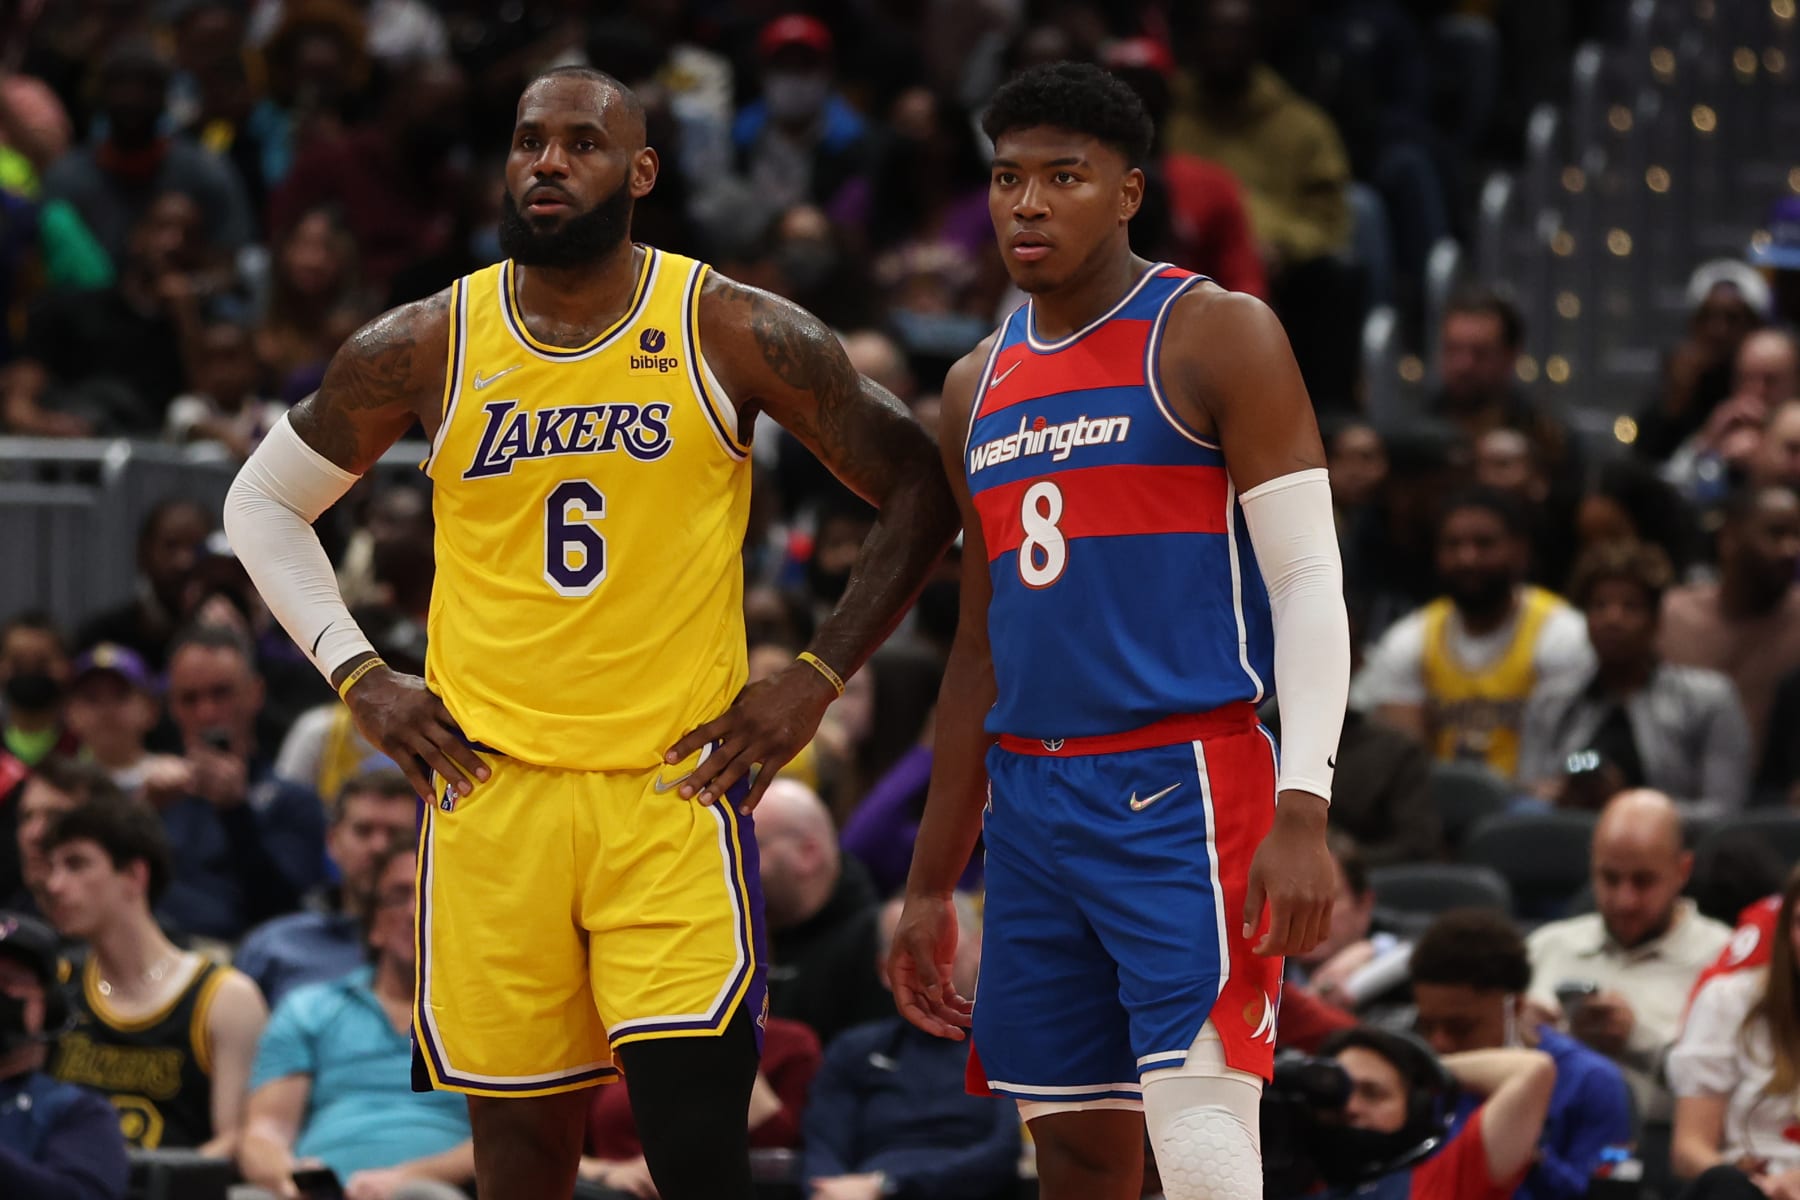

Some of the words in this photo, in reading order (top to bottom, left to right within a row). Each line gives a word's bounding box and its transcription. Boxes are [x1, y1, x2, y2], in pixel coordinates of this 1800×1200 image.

[630, 355, 678, 373] bibigo
[461, 399, 674, 481] LAKERS
[969, 414, 1131, 475] washington
[543, 478, 607, 597] 6
[1017, 477, 1069, 590] 8
